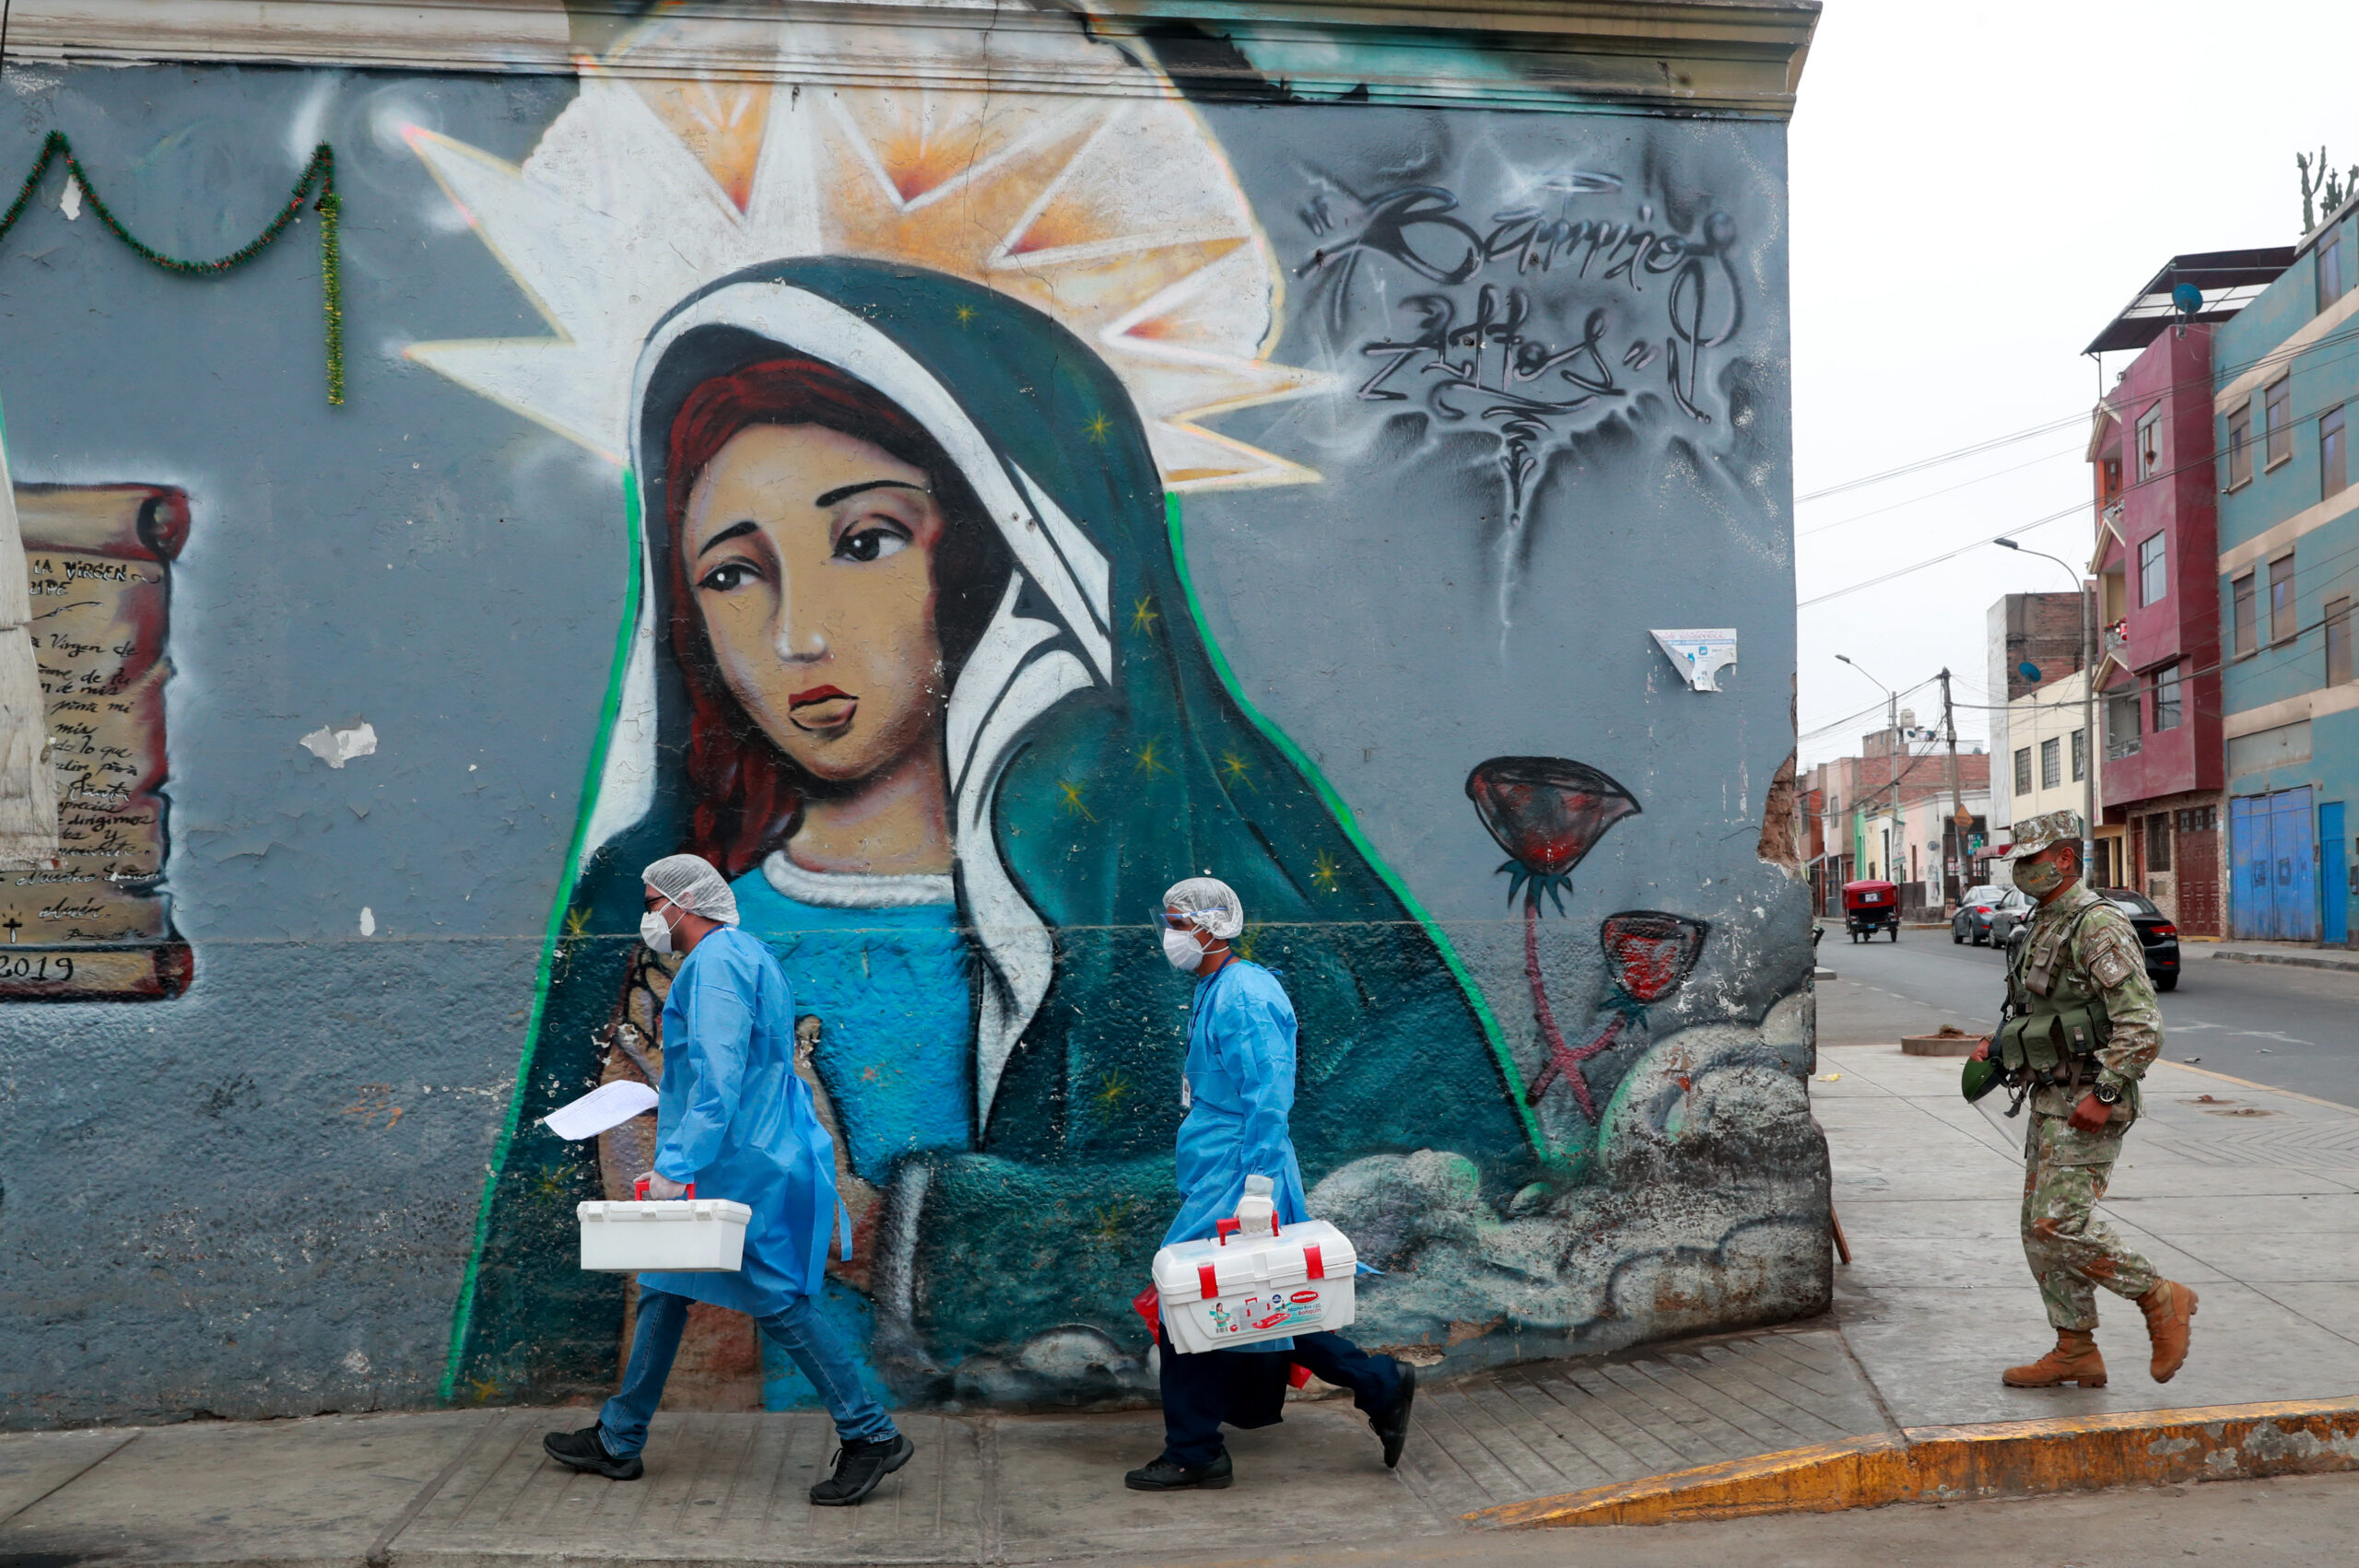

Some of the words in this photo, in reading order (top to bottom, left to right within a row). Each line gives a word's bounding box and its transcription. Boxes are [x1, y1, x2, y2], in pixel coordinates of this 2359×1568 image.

[34, 559, 53, 574] LA
[50, 634, 105, 658] Virgen
[113, 641, 139, 657] de
[80, 669, 103, 683] de
[111, 667, 131, 685] tu
[55, 682, 75, 694] de
[80, 685, 122, 696] mis
[108, 701, 135, 713] mi
[79, 735, 96, 754] lo
[100, 746, 134, 760] que
[67, 814, 155, 832] dirigimos
[0, 954, 75, 981] 2019
